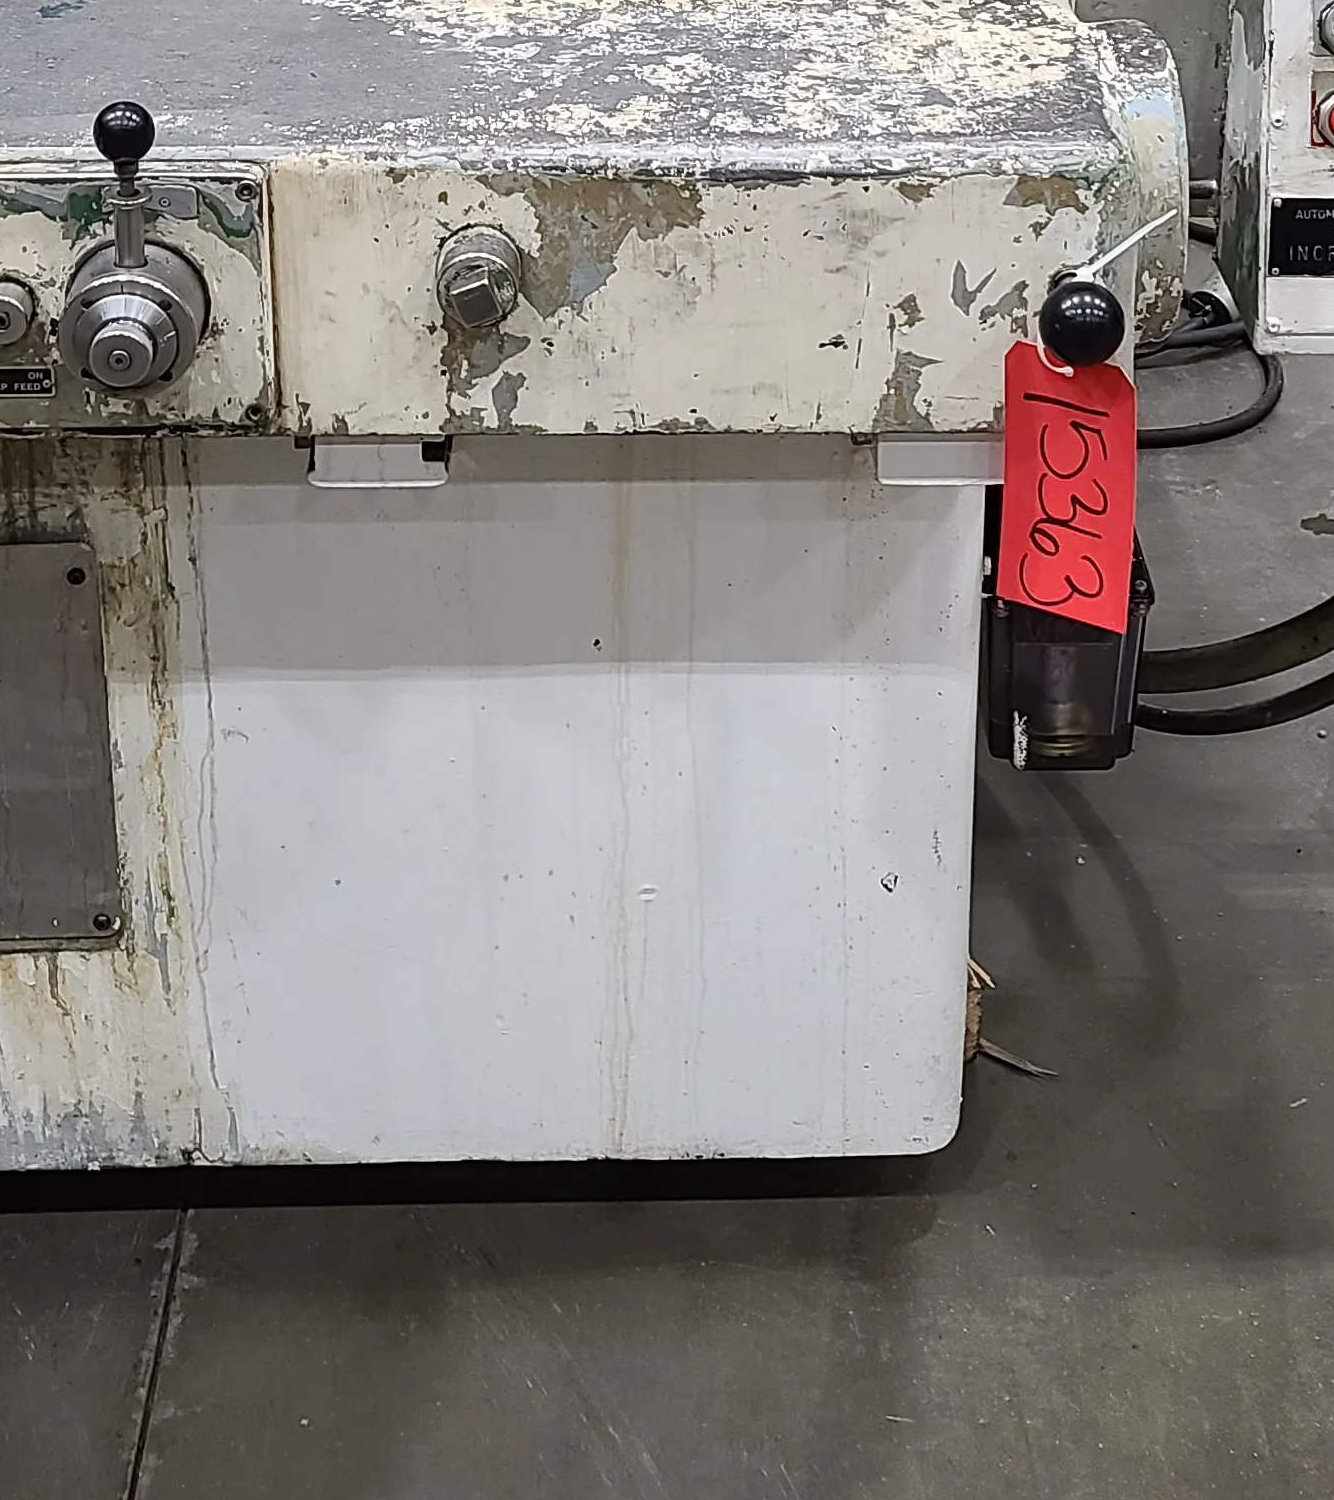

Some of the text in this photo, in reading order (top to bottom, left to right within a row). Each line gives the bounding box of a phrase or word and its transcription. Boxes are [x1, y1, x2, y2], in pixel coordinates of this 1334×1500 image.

[28, 371, 44, 380] ON
[14, 382, 41, 391] FEED
[1020, 391, 1110, 606] 15363
